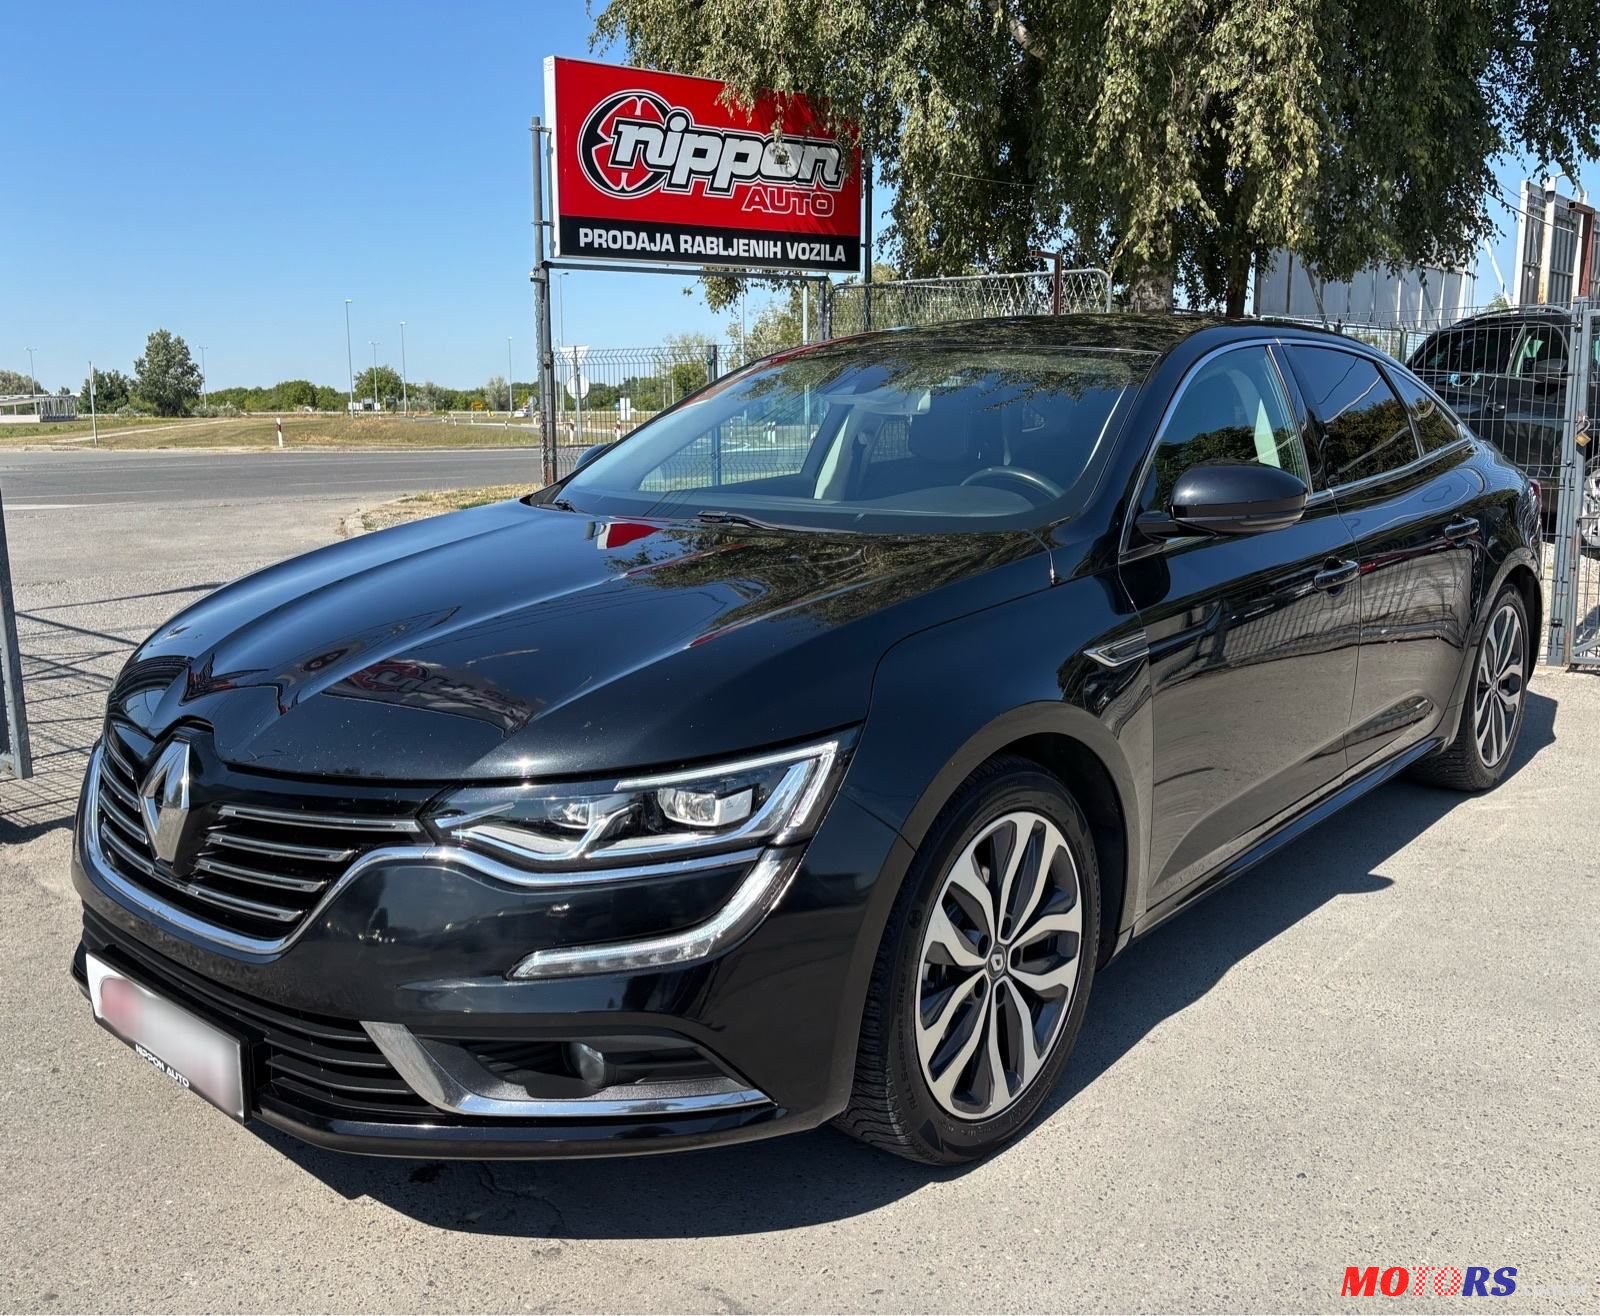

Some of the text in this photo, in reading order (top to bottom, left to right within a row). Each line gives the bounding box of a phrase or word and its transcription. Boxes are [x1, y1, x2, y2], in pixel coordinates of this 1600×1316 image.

[610, 109, 844, 195] nippon
[741, 187, 835, 217] AUTO
[579, 227, 847, 262] PRODAJA RABLJENIH VOZILA
[166, 1066, 190, 1088] AUTO
